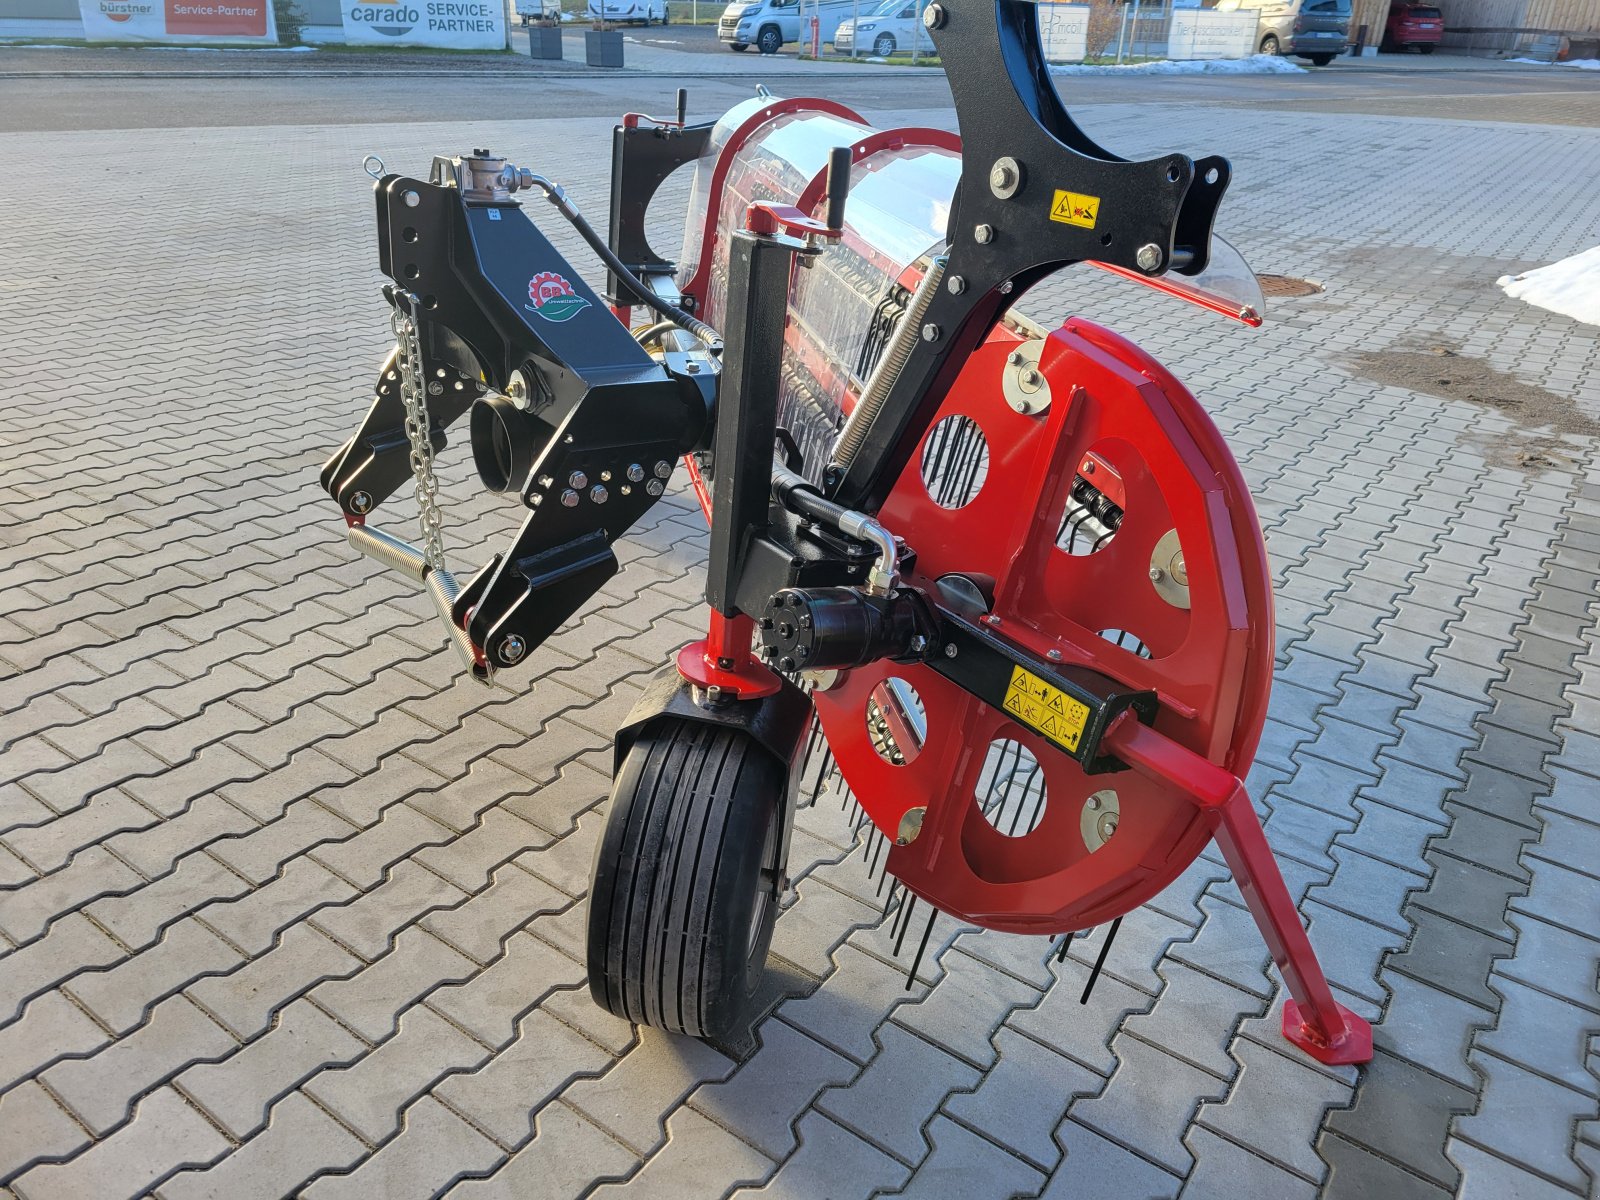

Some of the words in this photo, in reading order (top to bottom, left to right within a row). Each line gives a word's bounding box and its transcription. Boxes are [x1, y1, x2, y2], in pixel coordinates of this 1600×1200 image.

[100, 3, 151, 13] bürstner
[174, 5, 258, 16] Service-Partner
[351, 5, 420, 23] carado
[426, 2, 494, 17] SERVICE-
[428, 19, 495, 33] PARTNER
[541, 287, 562, 297] BB
